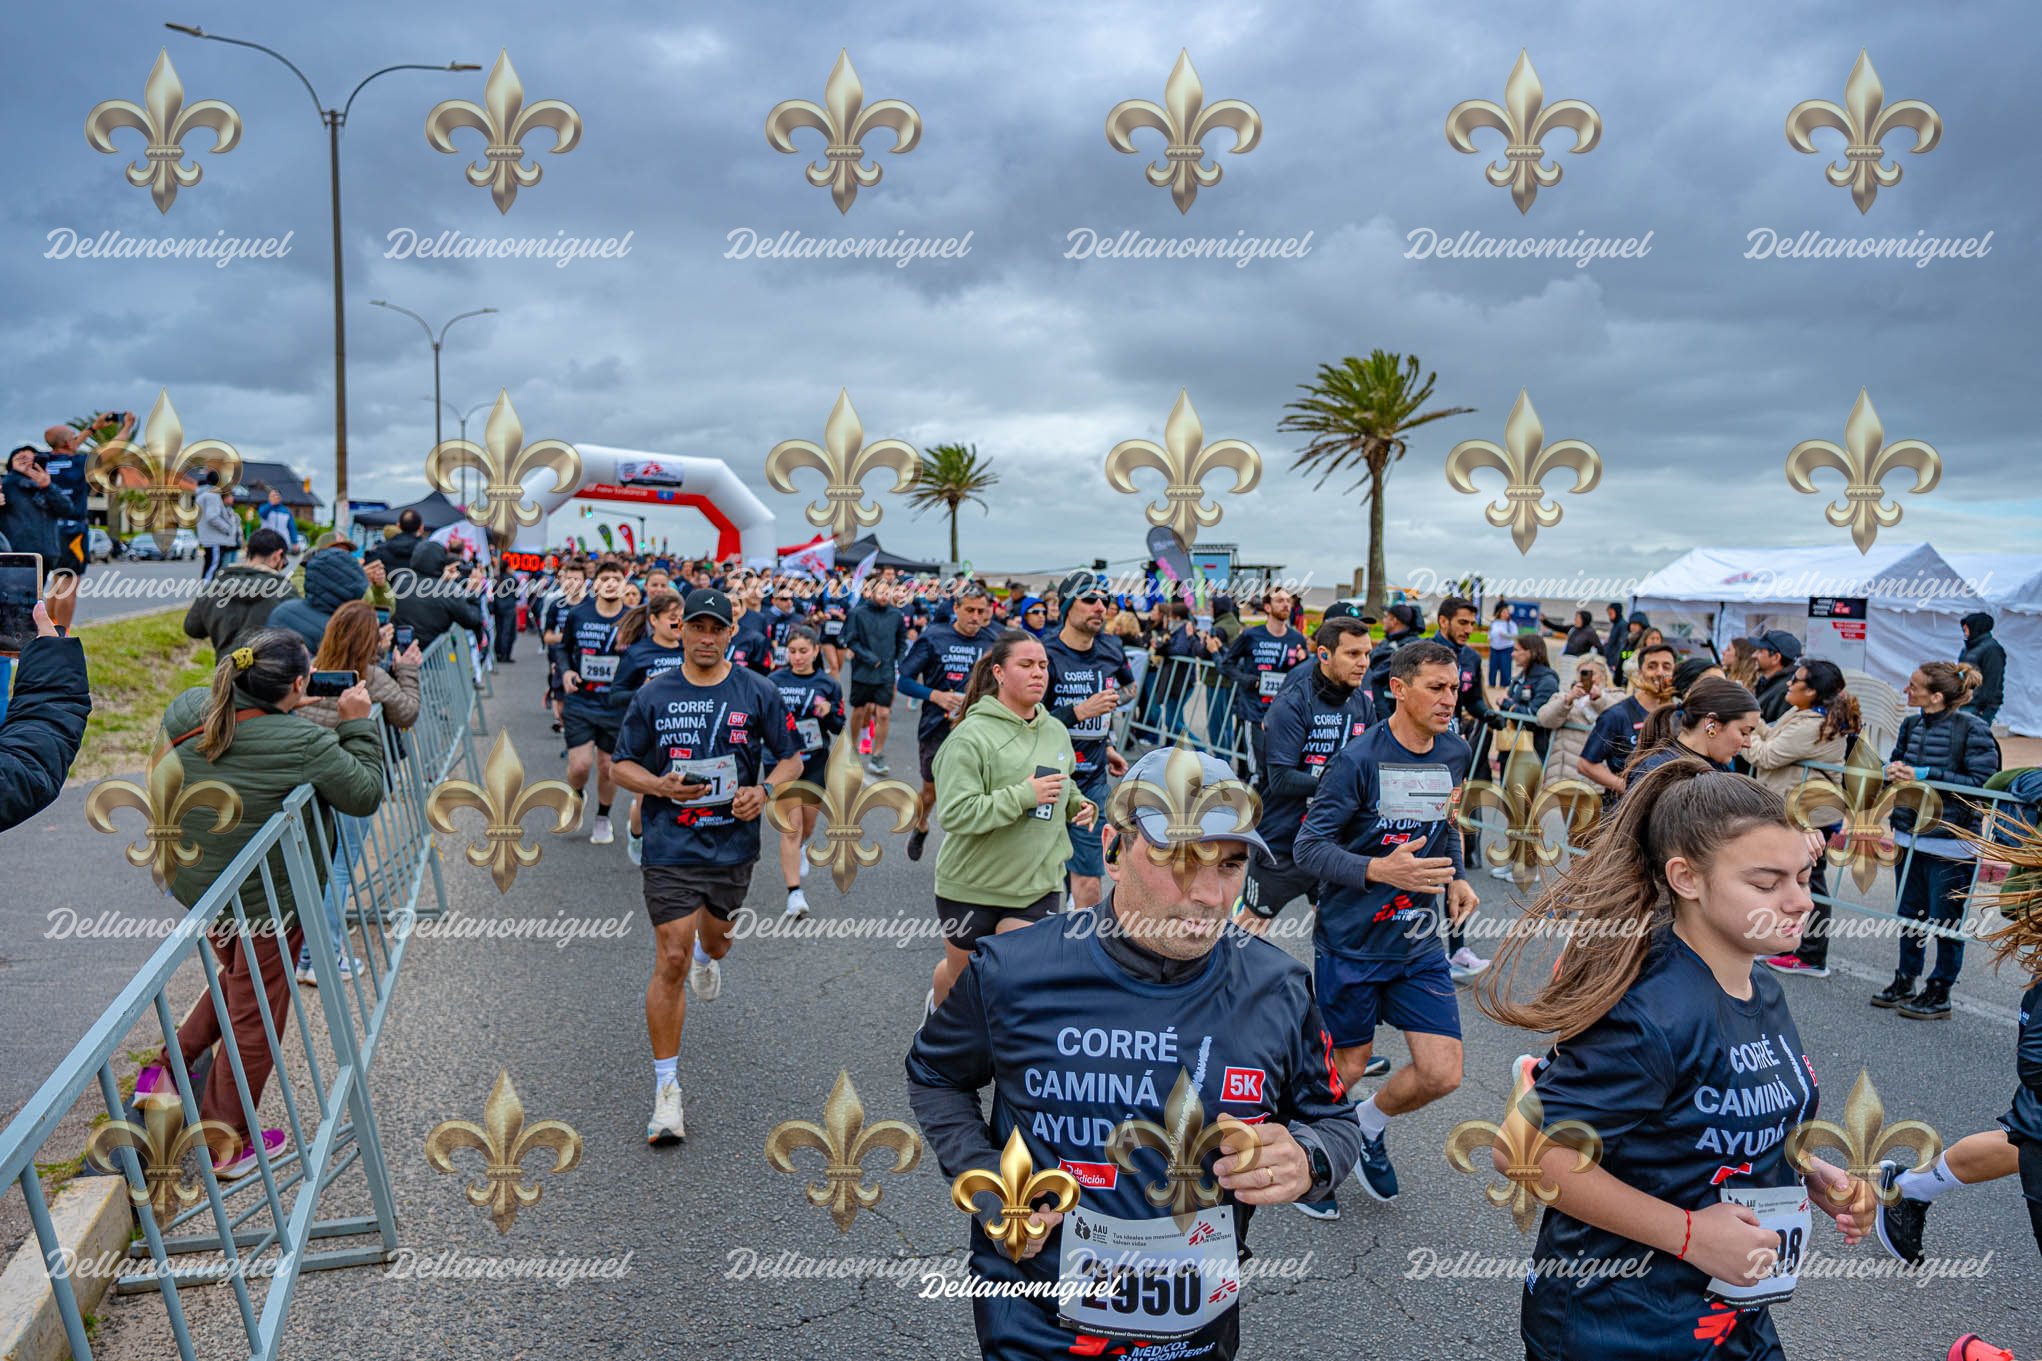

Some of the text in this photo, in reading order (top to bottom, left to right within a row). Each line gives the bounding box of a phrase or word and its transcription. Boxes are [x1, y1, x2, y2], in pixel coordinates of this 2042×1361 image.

[586, 664, 611, 677] 2994
[668, 699, 714, 714] CORRÉ
[655, 714, 707, 731] CAMINÁ
[659, 730, 701, 747] AYUDÁ
[1308, 726, 1340, 740] AMINÁ
[1057, 1026, 1178, 1062] CORRÉ
[1025, 1068, 1160, 1107] CAMINÁ
[1230, 1074, 1258, 1096] 5K
[1694, 1074, 1797, 1117] CAMINÁ
[1032, 1111, 1143, 1149] AYUDÁ
[1696, 1116, 1787, 1156] AYUDÁ
[1093, 1223, 1108, 1235] AAU
[1081, 1258, 1202, 1316] 2950
[1131, 1341, 1190, 1357] MEDICOS
